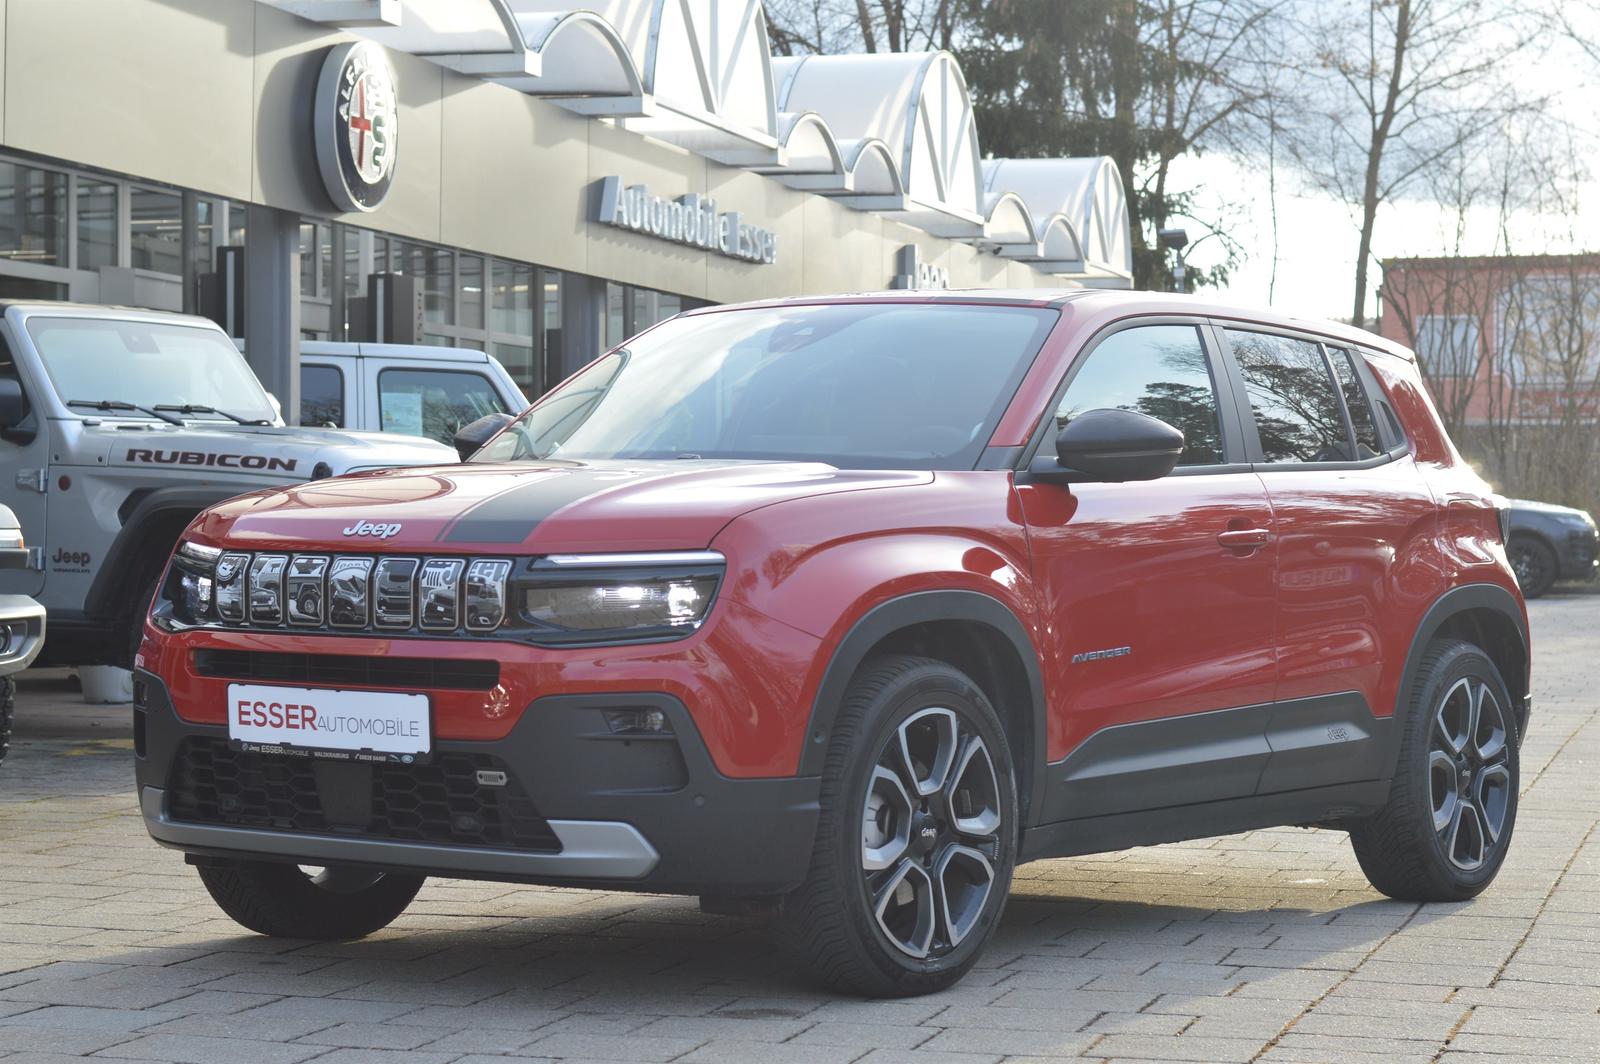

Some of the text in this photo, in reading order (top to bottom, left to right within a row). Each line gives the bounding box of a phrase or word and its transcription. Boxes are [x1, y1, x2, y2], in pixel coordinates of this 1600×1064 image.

[601, 175, 777, 264] Automobile Esser
[126, 448, 298, 472] RUBICON
[343, 519, 402, 540] Jeep
[52, 547, 91, 567] Jeep
[1071, 646, 1132, 664] AVENGER
[237, 700, 318, 731] ESSER
